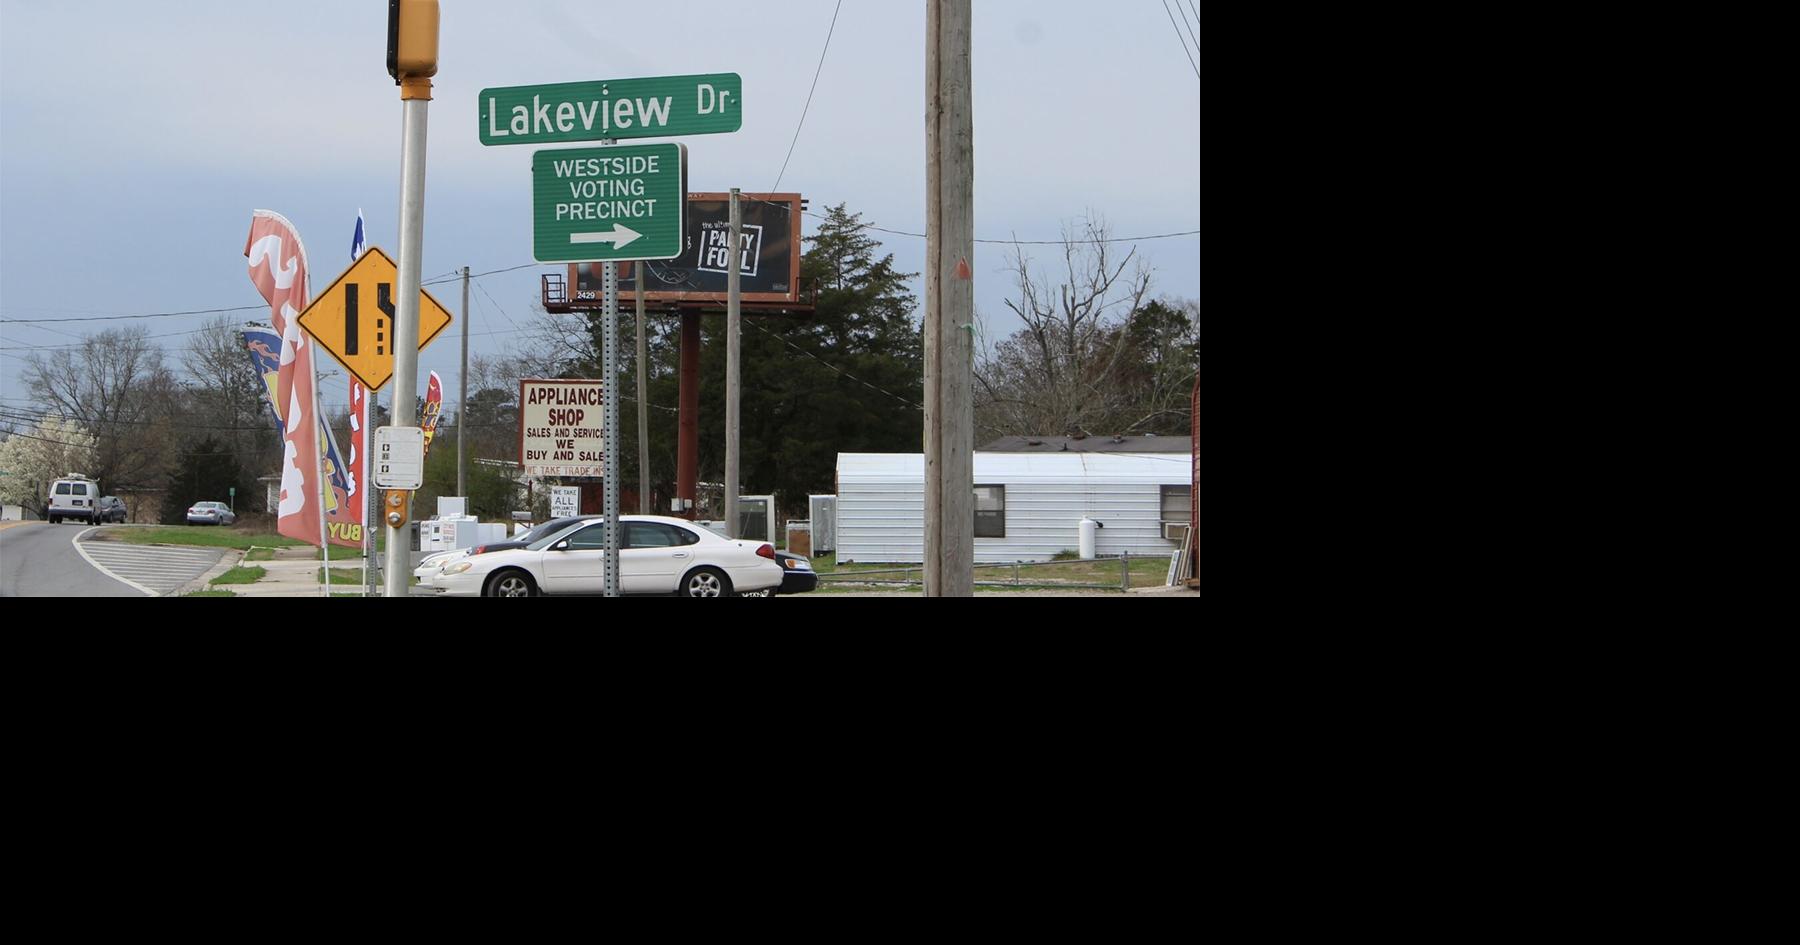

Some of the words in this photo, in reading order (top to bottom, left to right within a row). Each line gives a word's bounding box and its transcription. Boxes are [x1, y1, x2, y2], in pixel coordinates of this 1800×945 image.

[488, 89, 673, 137] Lakeview
[697, 84, 730, 115] Dr
[553, 155, 660, 178] WESTSIDE
[569, 179, 645, 199] VOTING
[555, 199, 657, 221] PRECINCT
[708, 229, 755, 250] PATY
[706, 246, 751, 271] FOL
[577, 291, 596, 299] 2429
[528, 387, 603, 406] APPLIANCE
[548, 408, 585, 427] SHOP
[526, 427, 551, 438] SALES
[554, 427, 570, 438] AND
[573, 427, 603, 439] SERVICE
[556, 439, 575, 449] WE
[526, 450, 548, 460] BUY
[553, 450, 575, 461] AND
[578, 451, 604, 462] SALE
[527, 466, 537, 475] WE
[541, 466, 561, 475] TAKE
[564, 466, 590, 475] TRADE
[555, 496, 574, 505] ALL
